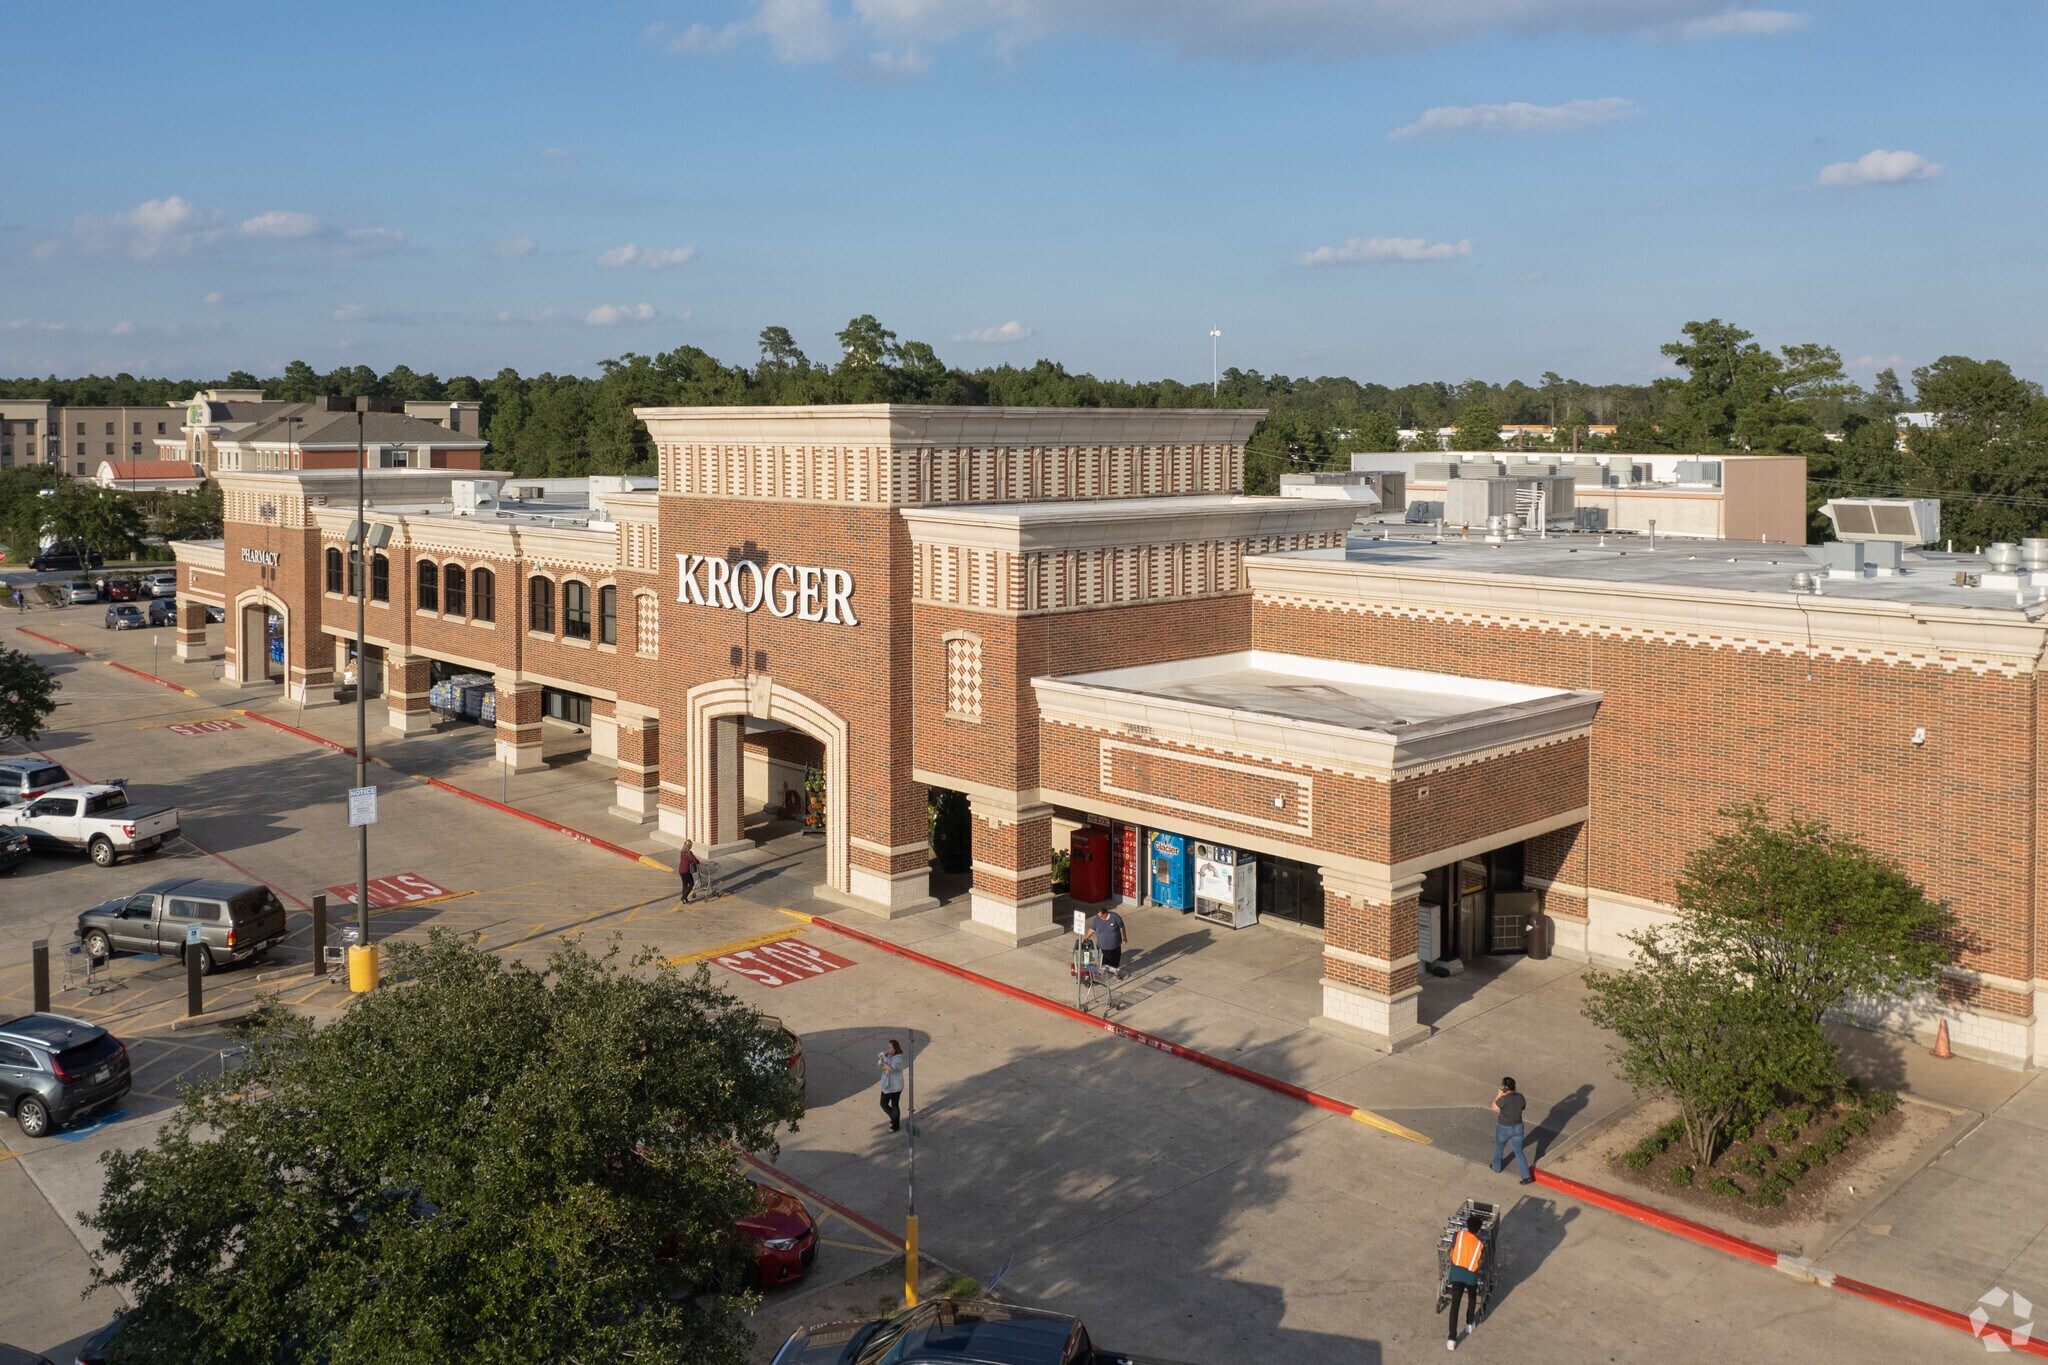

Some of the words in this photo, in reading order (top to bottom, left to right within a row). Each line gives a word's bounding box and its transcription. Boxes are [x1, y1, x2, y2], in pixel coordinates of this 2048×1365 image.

[241, 547, 278, 567] PHARMACY
[675, 553, 858, 627] KROGER
[169, 720, 234, 735] STOP
[350, 787, 376, 797] NOTICE
[1154, 841, 1179, 855] Glacier
[717, 941, 841, 985] STOP
